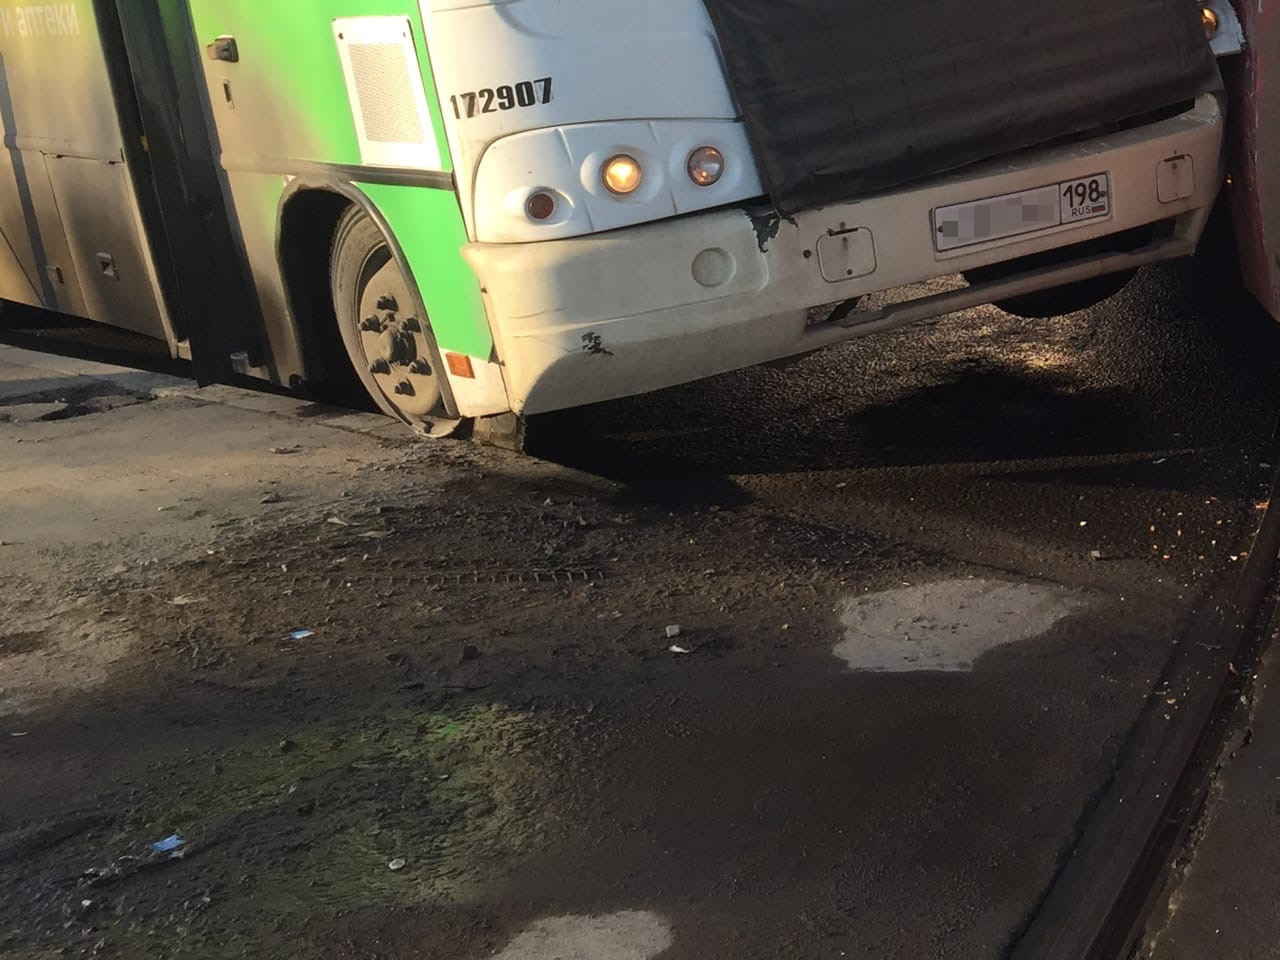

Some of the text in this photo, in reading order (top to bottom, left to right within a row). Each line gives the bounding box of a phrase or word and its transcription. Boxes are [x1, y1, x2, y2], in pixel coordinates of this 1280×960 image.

[450, 76, 553, 120] 172907
[1062, 178, 1101, 209] 198
[1071, 204, 1092, 217] RUS
